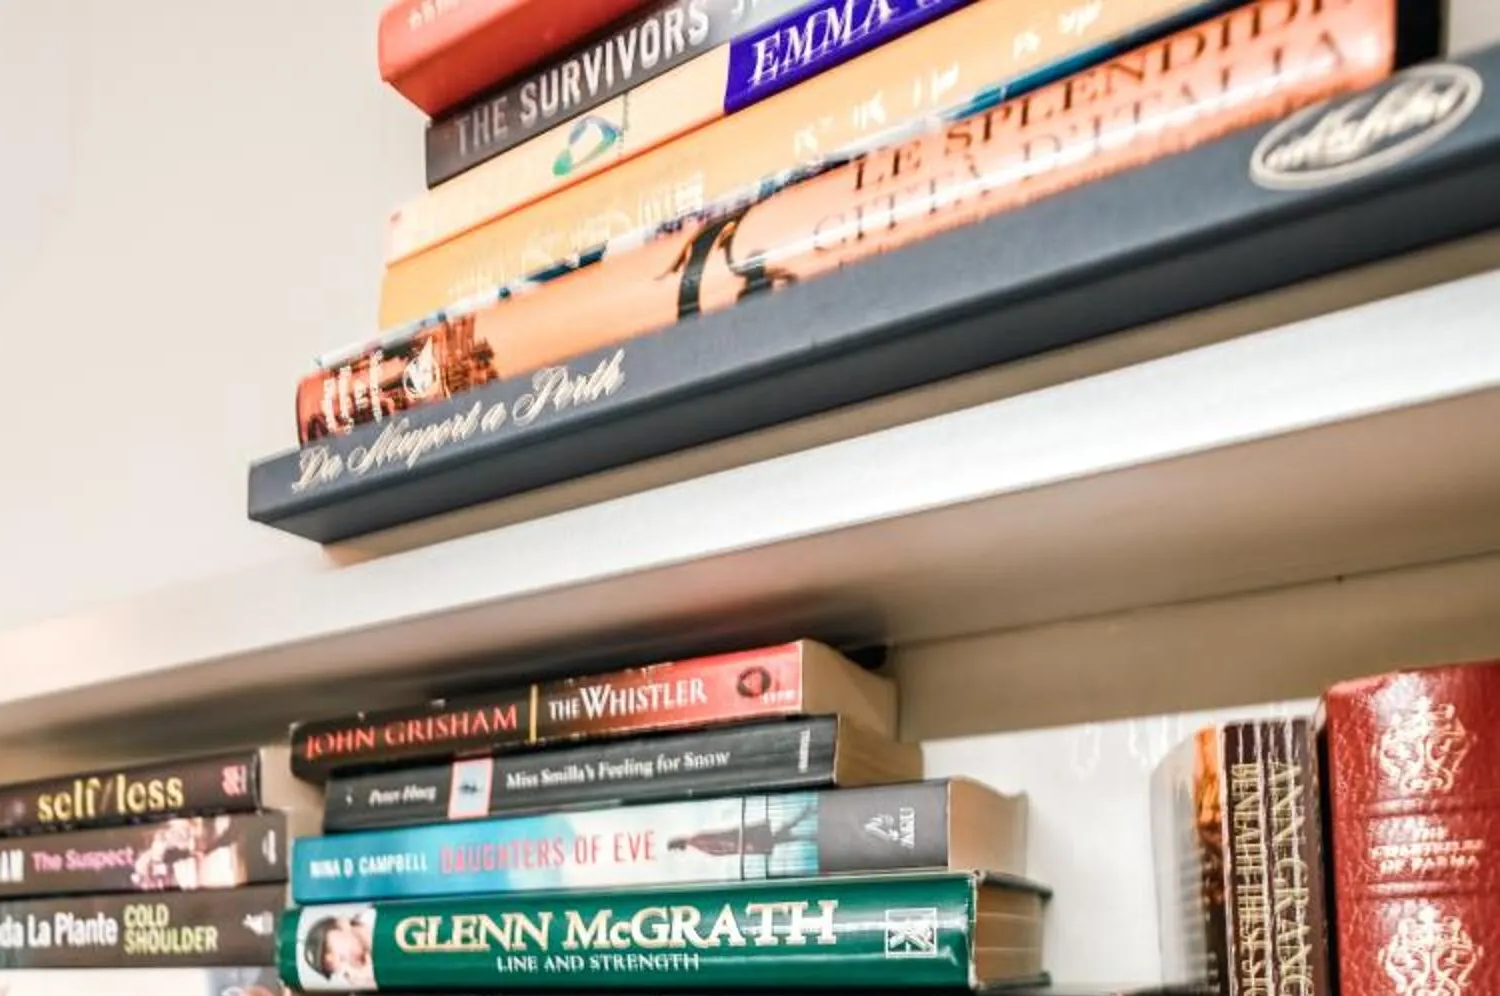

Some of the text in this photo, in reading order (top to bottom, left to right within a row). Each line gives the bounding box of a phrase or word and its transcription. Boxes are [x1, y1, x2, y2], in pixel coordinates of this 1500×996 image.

[748, 0, 895, 87] EMMA
[454, 95, 509, 157] THE
[518, 0, 710, 127] SURVIVORS
[853, 138, 924, 192] LE
[548, 676, 708, 721] THE WHISTLER
[305, 703, 518, 760] JOHN GRISHAM
[506, 771, 539, 790] Miss
[598, 757, 654, 781] Feeling
[656, 753, 682, 774] for
[683, 751, 731, 771] Snow
[1269, 761, 1307, 847] ANN
[32, 845, 136, 873] The Suspect
[358, 852, 428, 876] CAMPBELL
[438, 830, 657, 875] DAUGHTERS OF EVE
[26, 913, 52, 947] La
[54, 910, 119, 947] Plante
[123, 904, 171, 929] COLD
[394, 898, 840, 953] GLENN McGRATH
[123, 925, 219, 955] SHOULDER
[496, 952, 700, 974] LINE AND STRENGTH
